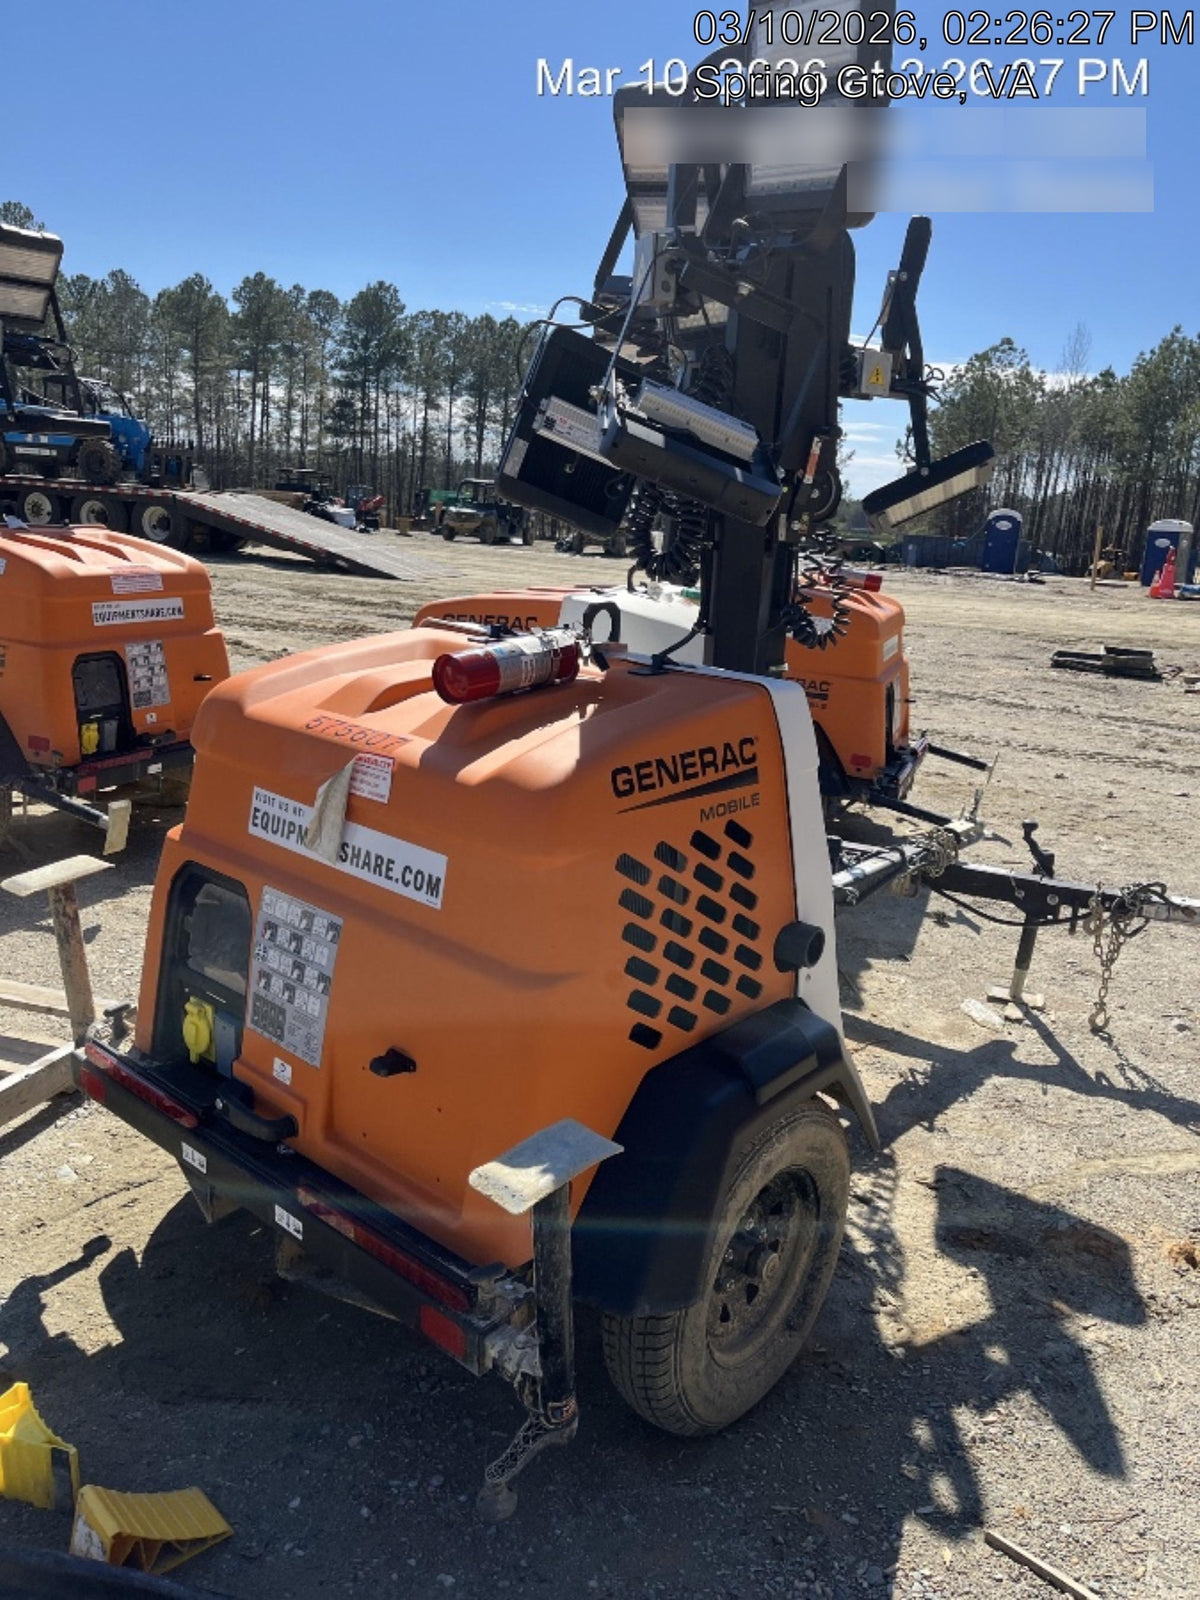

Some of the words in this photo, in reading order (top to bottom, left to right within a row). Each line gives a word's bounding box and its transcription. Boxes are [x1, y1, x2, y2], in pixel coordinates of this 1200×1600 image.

[611, 736, 757, 798] GENERAC
[256, 790, 276, 808] VISIT
[700, 792, 760, 823] MOBILE
[251, 806, 442, 900] EQUIPMSHARE.COM
